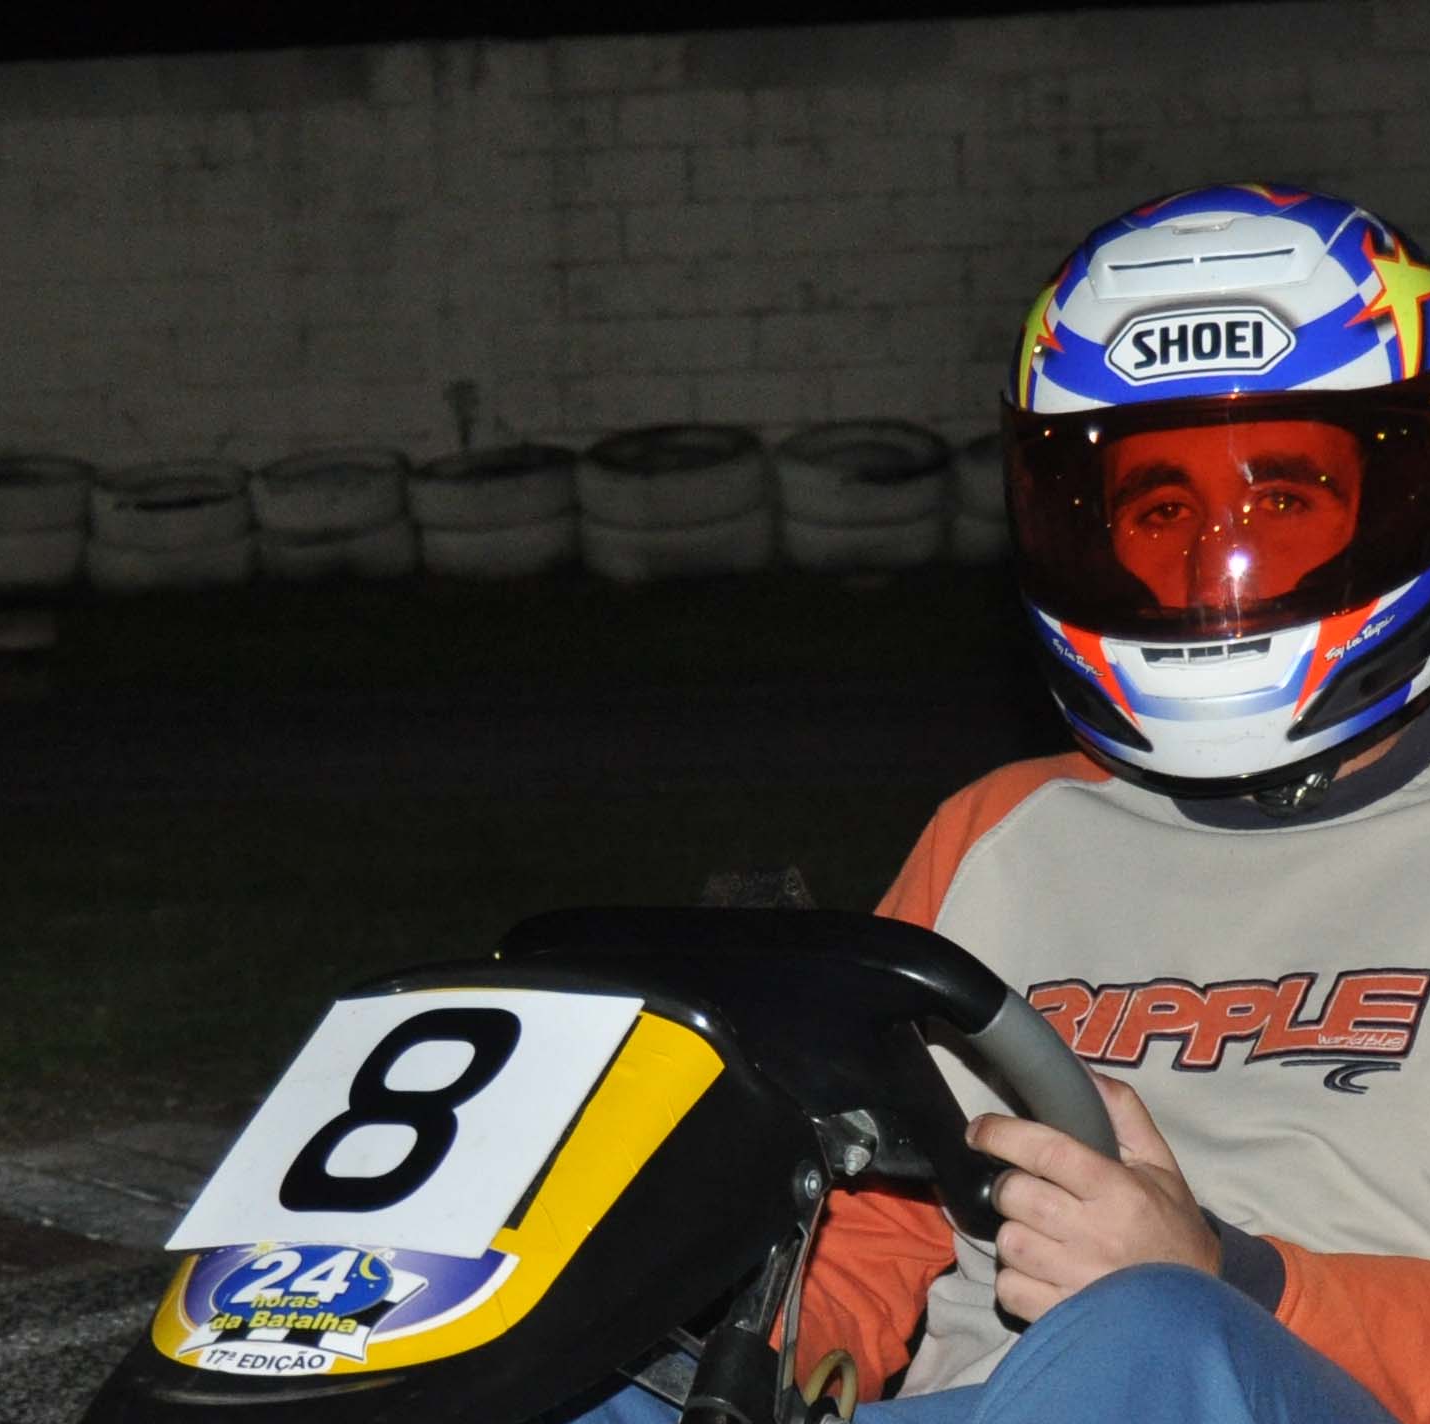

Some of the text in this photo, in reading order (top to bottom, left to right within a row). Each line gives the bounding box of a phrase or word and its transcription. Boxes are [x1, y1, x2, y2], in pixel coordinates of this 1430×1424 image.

[1132, 320, 1264, 370] SHOEI
[279, 1006, 522, 1213] 8
[230, 1249, 361, 1304] 24
[250, 1293, 320, 1310] horas
[210, 1310, 359, 1334] da Batalha
[237, 1350, 327, 1372] EDIÇÃO
